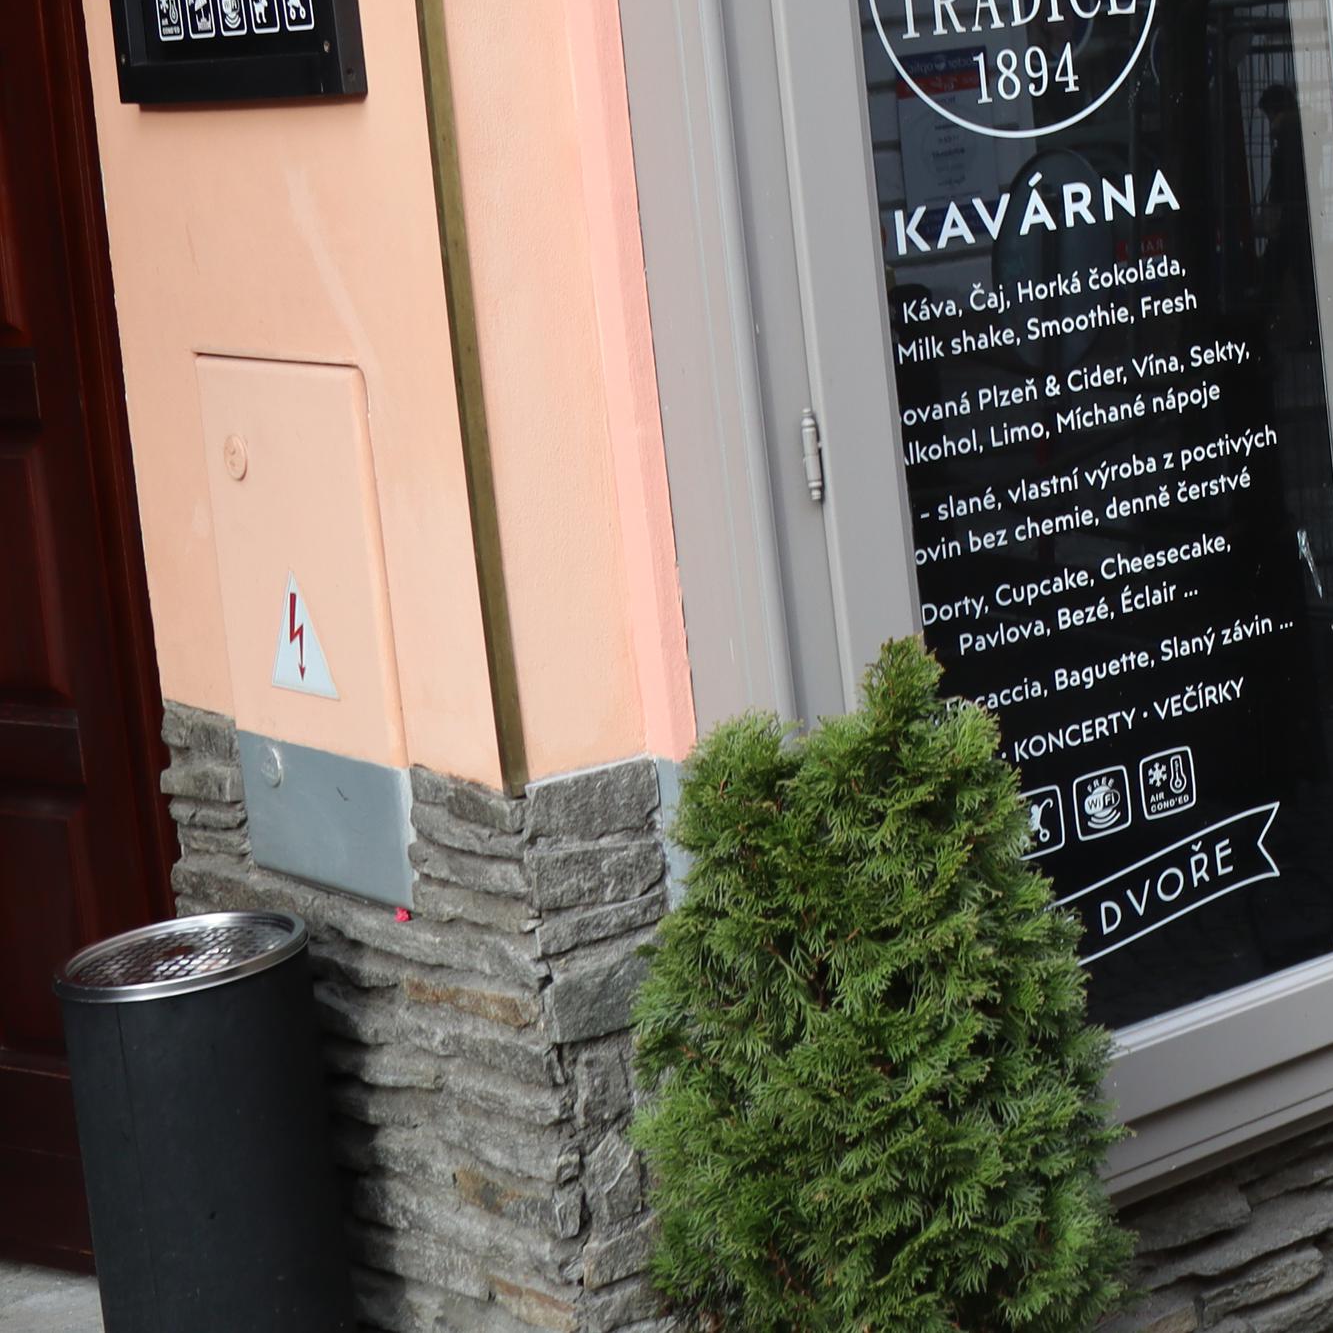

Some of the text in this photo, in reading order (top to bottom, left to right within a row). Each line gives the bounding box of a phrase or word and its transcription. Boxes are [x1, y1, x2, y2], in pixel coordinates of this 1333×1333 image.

[972, 41, 1080, 105] 1894
[895, 169, 1180, 255] KAVÁRNA
[897, 290, 1198, 365] Milk shake, Smoothie, Fresh
[903, 255, 1187, 324] Káva, Čaj, Horká čokoláda,
[900, 338, 1251, 427] ovaná Plzeň & Cider, Vína, Sekty,
[989, 417, 1051, 449] Limo,
[1056, 398, 1146, 436] Míchané
[1152, 379, 1221, 415] nápoje
[937, 424, 1278, 522] slané, vlastní výroba z poctivých
[968, 525, 1008, 553] bez
[1014, 504, 1100, 542] chemie,
[1105, 484, 1170, 520] denně
[1176, 468, 1252, 502] čerstvé
[921, 536, 1232, 628] Dorty, Cupcake, Cheesecake,
[959, 579, 1177, 655] Pavlova, Bezé, Éclair
[1054, 650, 1155, 692] Baguette,
[1160, 631, 1215, 663] Slaný
[1221, 616, 1273, 645] závin
[1014, 677, 1244, 762] KONCERTY VEČÍRKY
[1087, 776, 1115, 794] FREE
[1150, 793, 1165, 804] AIR
[1100, 838, 1234, 935] DVOŘE
